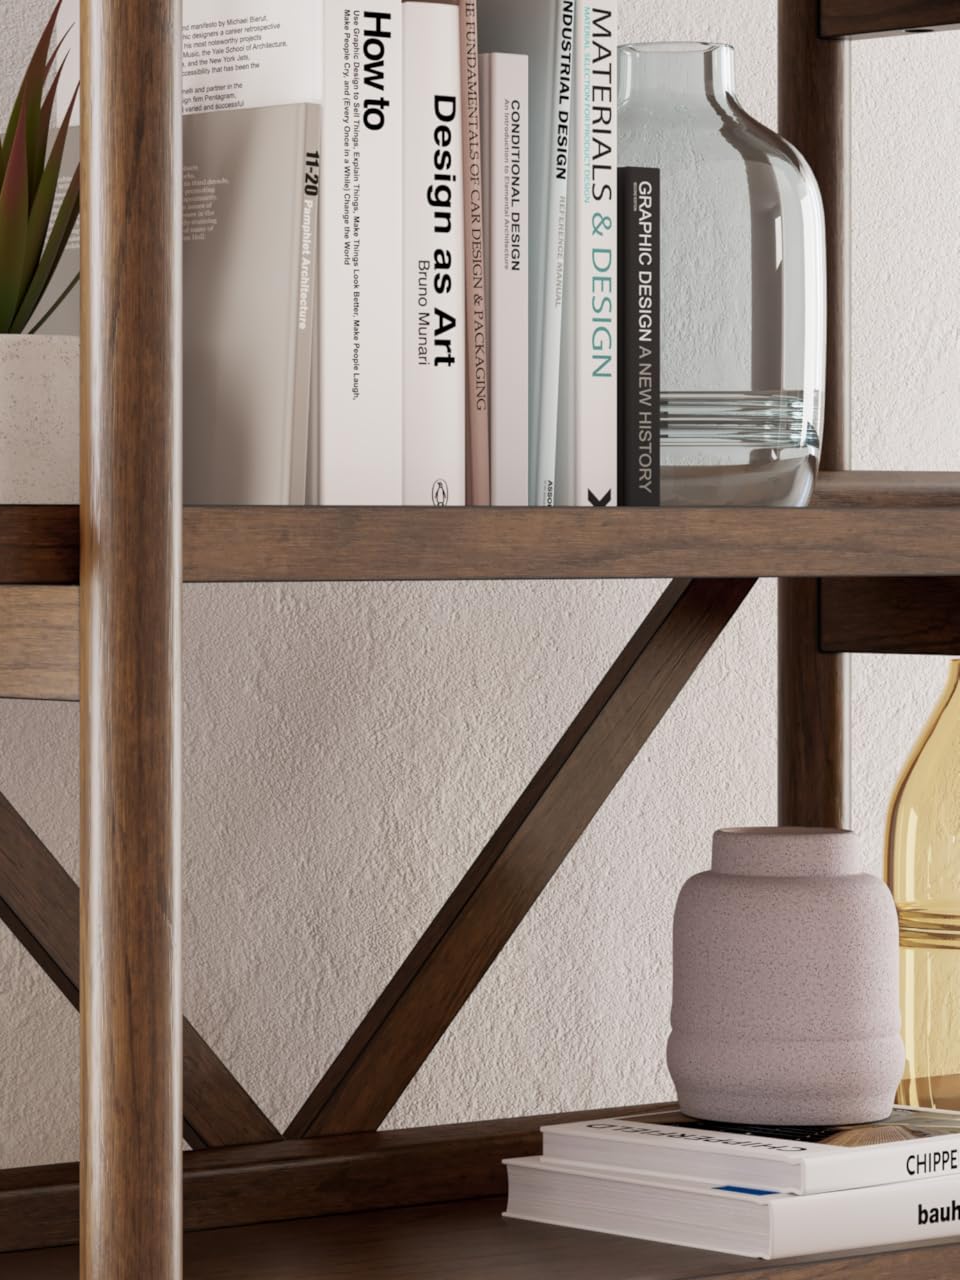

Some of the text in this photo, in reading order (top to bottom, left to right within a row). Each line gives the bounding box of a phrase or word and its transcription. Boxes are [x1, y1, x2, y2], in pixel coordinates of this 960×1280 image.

[192, 31, 218, 40] designers
[245, 24, 280, 32] retrospective
[352, 10, 360, 26] Use
[208, 38, 238, 46] noteworthy
[240, 35, 262, 43] projects
[343, 32, 351, 60] People
[352, 28, 360, 60] Graphic
[343, 62, 351, 78] Cry,
[352, 62, 360, 90] Design
[363, 11, 391, 130] How to
[206, 84, 225, 92] partner
[354, 92, 360, 100] to
[466, 22, 478, 160] FUNDAMENTALS
[555, 0, 573, 180] NDUSTRIAL DESIGN
[343, 98, 351, 124] (Every
[504, 99, 510, 110] An
[352, 120, 360, 150] Things,
[343, 166, 351, 191] While)
[352, 152, 360, 182] Explain
[470, 164, 480, 186] OF
[352, 184, 360, 214] Things,
[511, 100, 520, 271] CONDITIONAL DESIGN
[592, 8, 612, 378] MATERIALS & DESIGN
[343, 194, 351, 224] Change
[470, 190, 482, 224] CAR
[298, 150, 320, 330] 11-20 Pamphlet Architecture
[427, 94, 456, 367] Design as Art
[352, 240, 360, 266] Things
[472, 228, 483, 289] DESIGN
[555, 196, 566, 308] REFERENCE MANUAL
[352, 292, 360, 318] Better,
[418, 260, 430, 366] Bruno Munari
[474, 294, 482, 306] &
[638, 181, 652, 493] GRAPHIC DESIGN A NEW HISTORY
[352, 342, 360, 370] People
[474, 310, 486, 410] PACKAGING
[352, 372, 360, 400] Laugh,
[906, 1150, 958, 1175] CHIPPE
